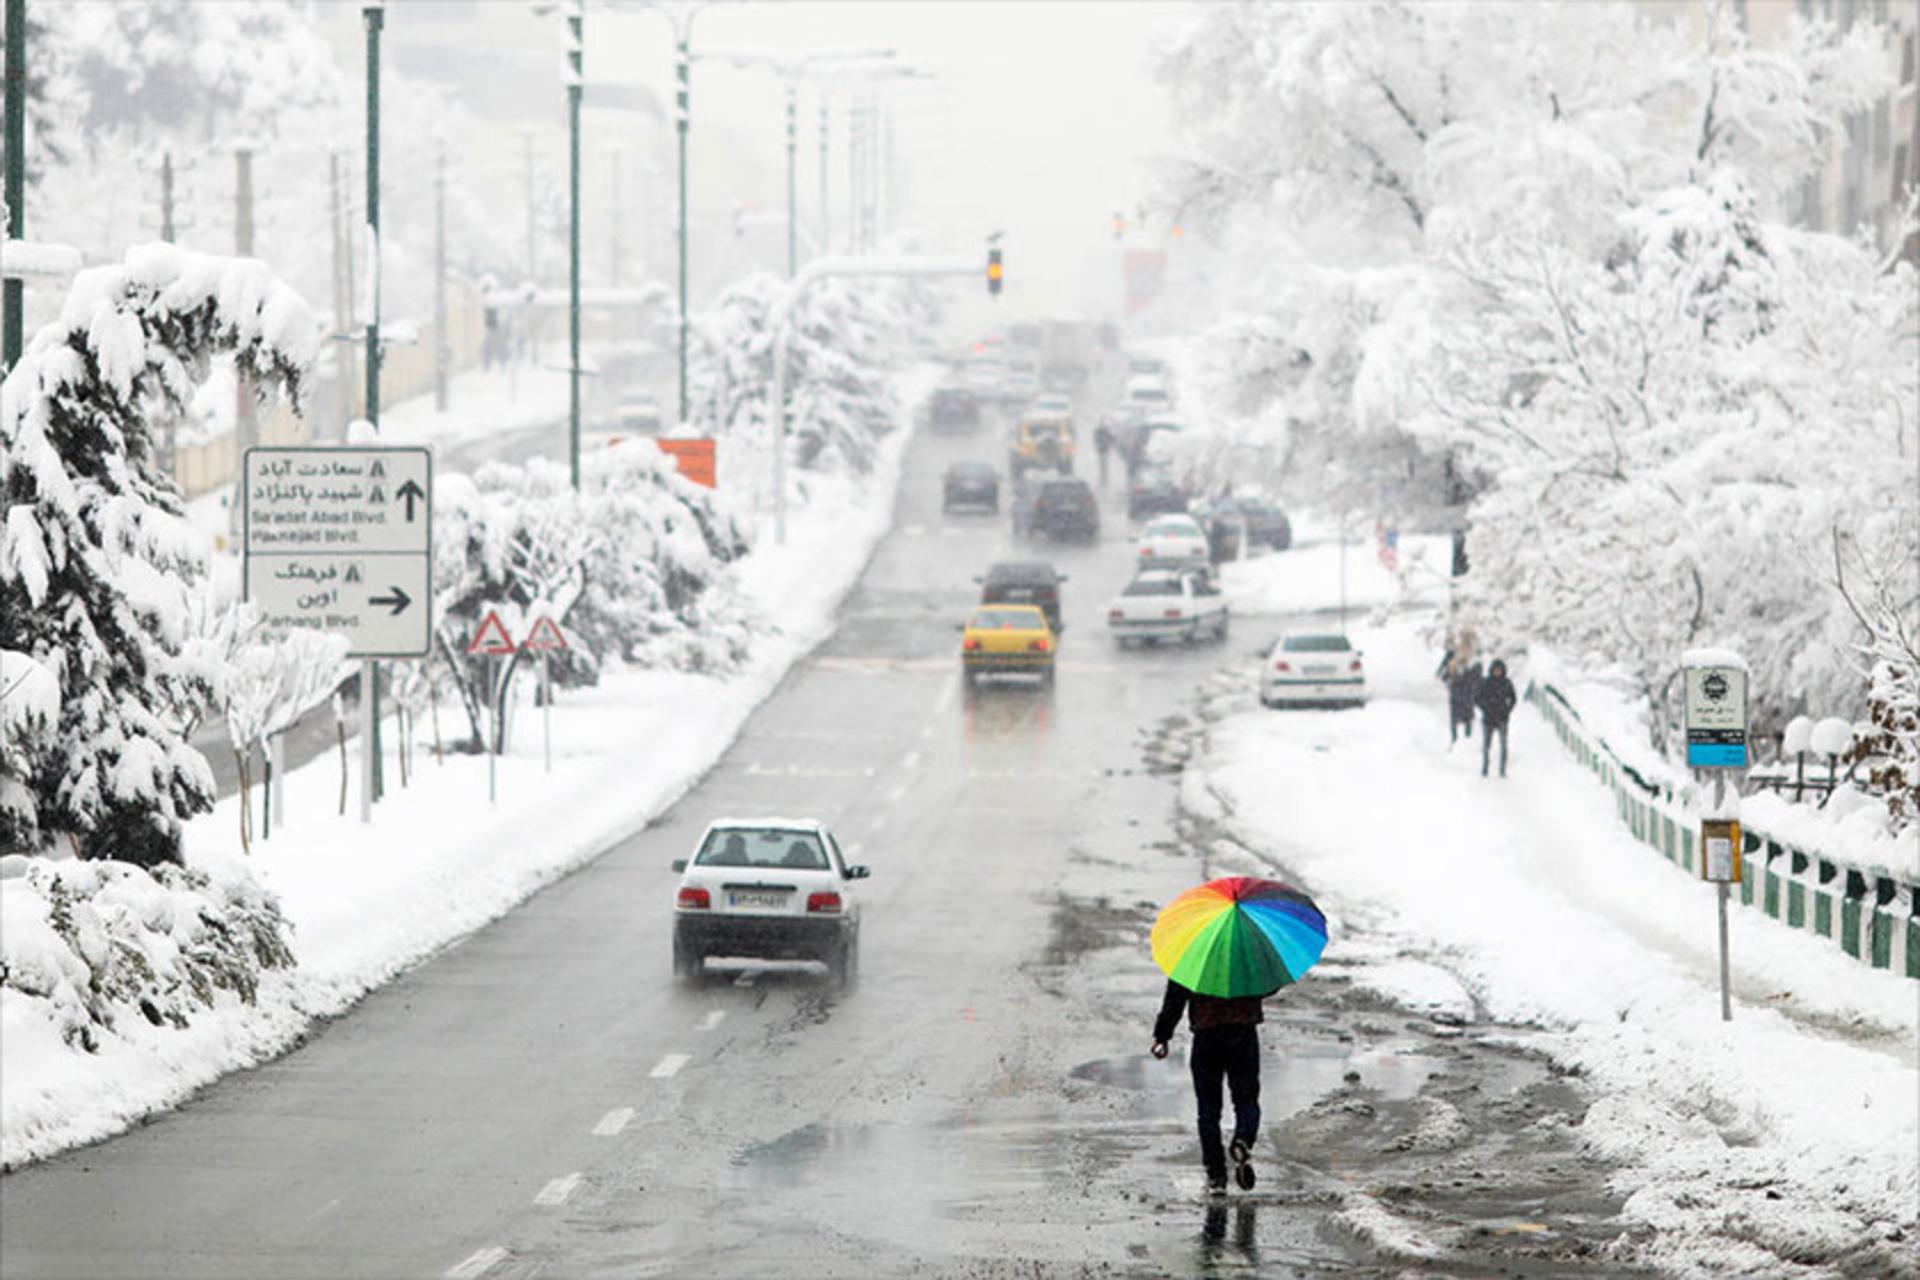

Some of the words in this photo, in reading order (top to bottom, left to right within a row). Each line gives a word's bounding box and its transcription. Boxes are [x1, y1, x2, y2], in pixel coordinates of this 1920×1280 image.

[259, 459, 292, 478] آباد
[297, 461, 363, 477] سعادت
[317, 484, 363, 502] شهید
